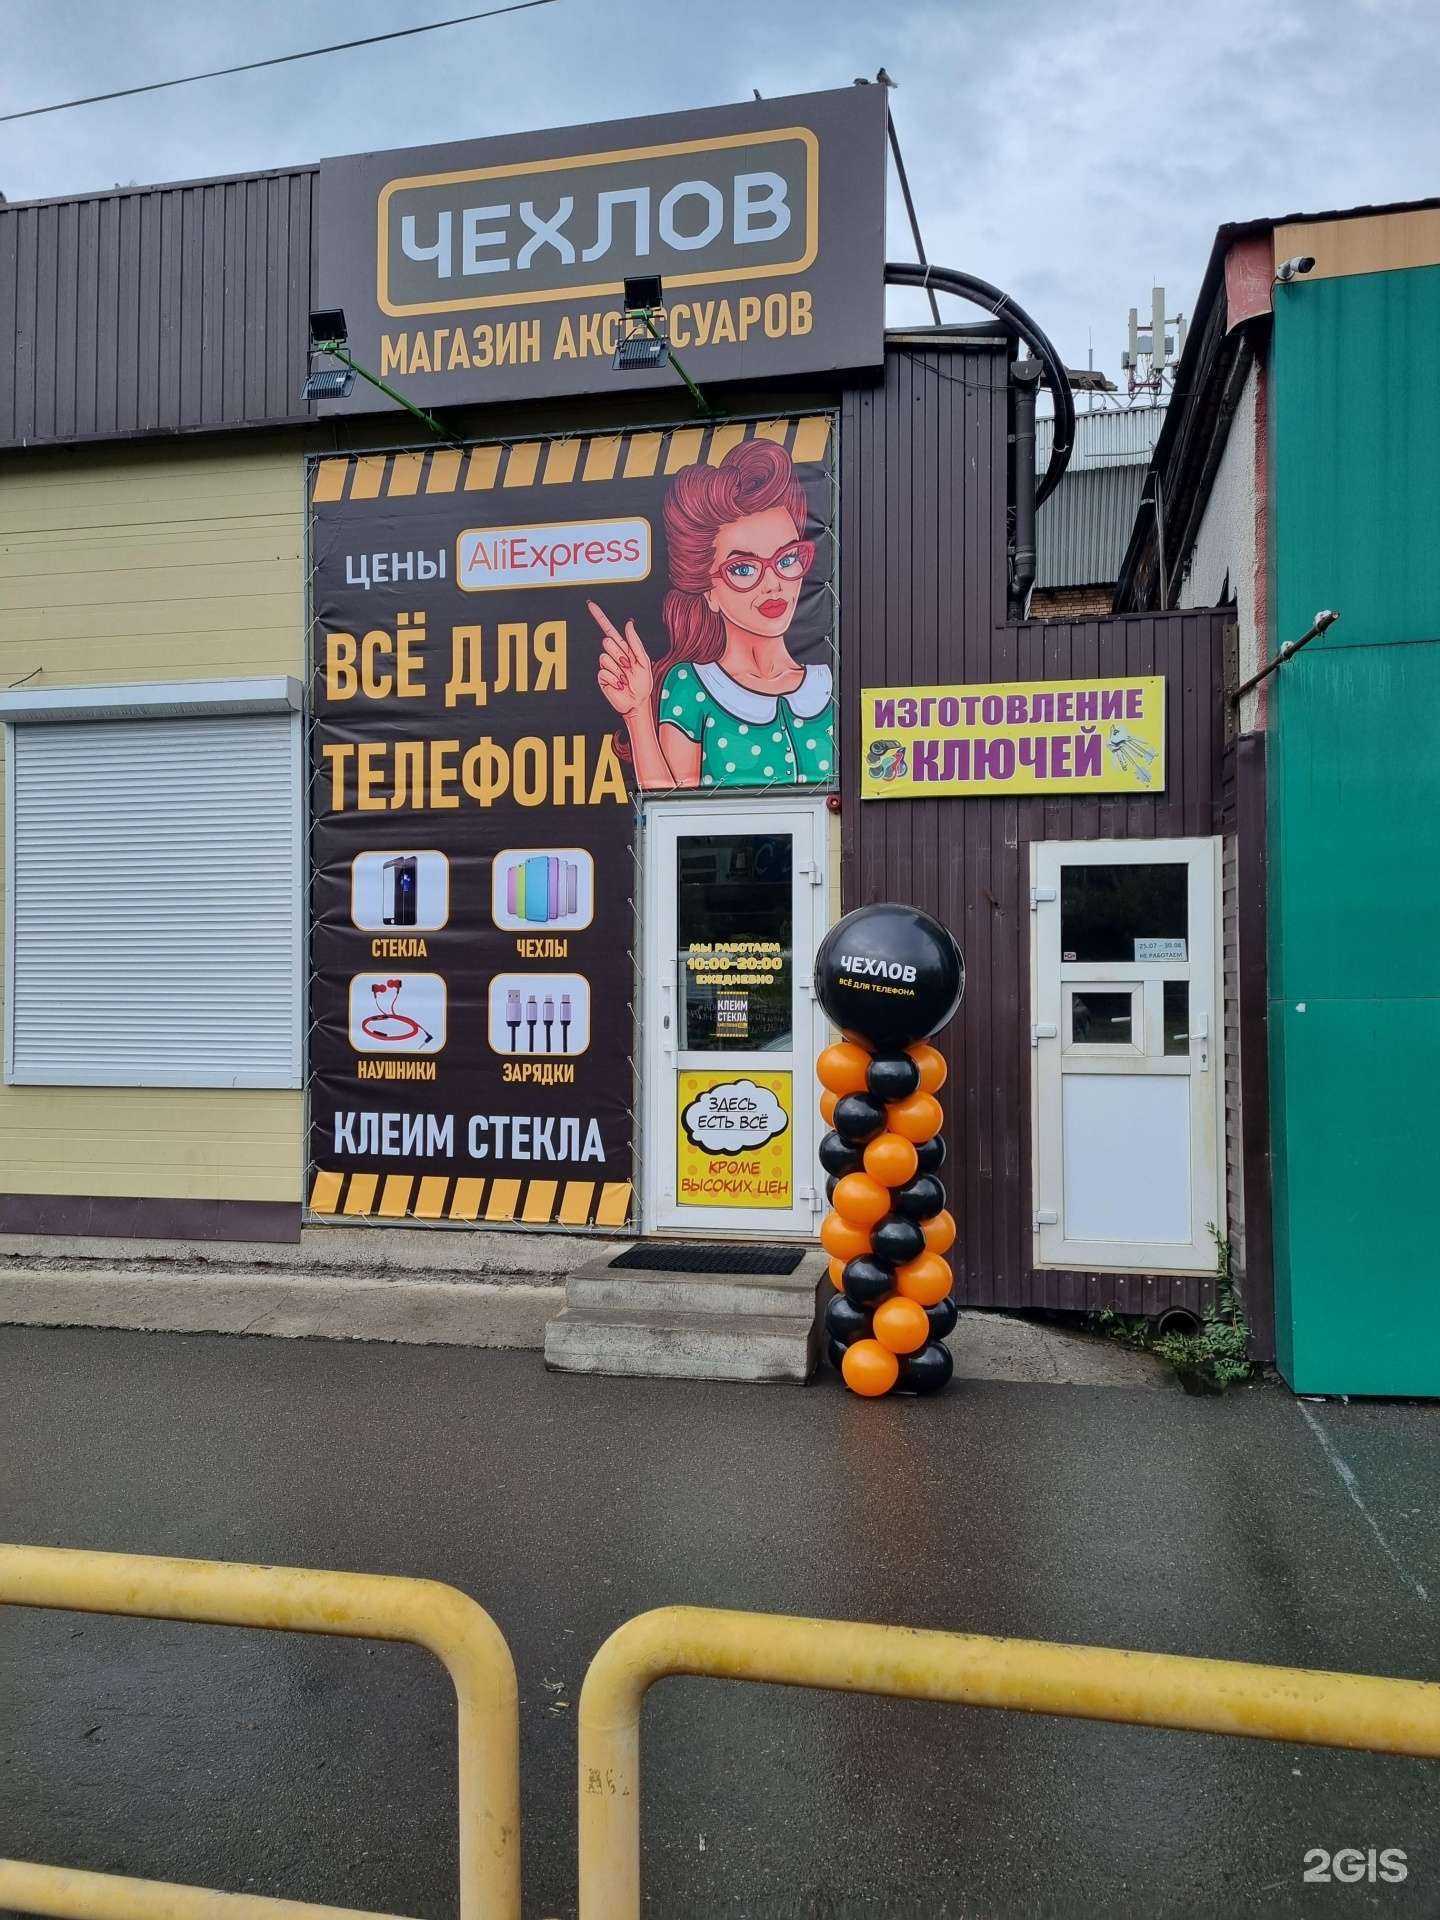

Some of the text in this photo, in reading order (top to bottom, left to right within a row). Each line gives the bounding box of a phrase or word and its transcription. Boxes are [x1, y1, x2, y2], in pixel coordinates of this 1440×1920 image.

[401, 171, 791, 278] ЧЕХЛОВ
[380, 319, 541, 377] МАГАЗИН
[468, 538, 641, 576] AliExpress
[345, 549, 446, 590] ЦЕНЫ
[326, 611, 567, 708] ВСЁ ДЛЯ
[874, 688, 1144, 729] ИЗГОТОВЛЕНИЕ
[911, 725, 1102, 782] КЛЮЧЕЙ
[322, 734, 629, 812] ТЕЛЕФОНА
[371, 937, 428, 958] СТЕКЛА
[516, 938, 568, 959] ЧЕХЛЫ
[689, 943, 780, 952] МЫ РАБОТАЕМ
[840, 955, 917, 983] ЧЕХЛОВ
[839, 978, 915, 996] ВСЁ ДЛЯ ТЕЛЕФОНА
[717, 1000, 748, 1011] КЛЕИМ
[717, 1012, 747, 1022] СТЕКЛА
[357, 1060, 436, 1081] НАУШНИКИ
[502, 1062, 575, 1085] ЗАРЯДКИ
[709, 1097, 757, 1112] ЗДЕСЬ
[698, 1113, 768, 1129] ЕСТЬ ВСЁ
[334, 1111, 606, 1163] КЛЕИМ СТЕКЛА
[708, 1161, 760, 1175] КРОМЕ
[681, 1178, 788, 1195] ВЫСОКИХ ЦЕН
